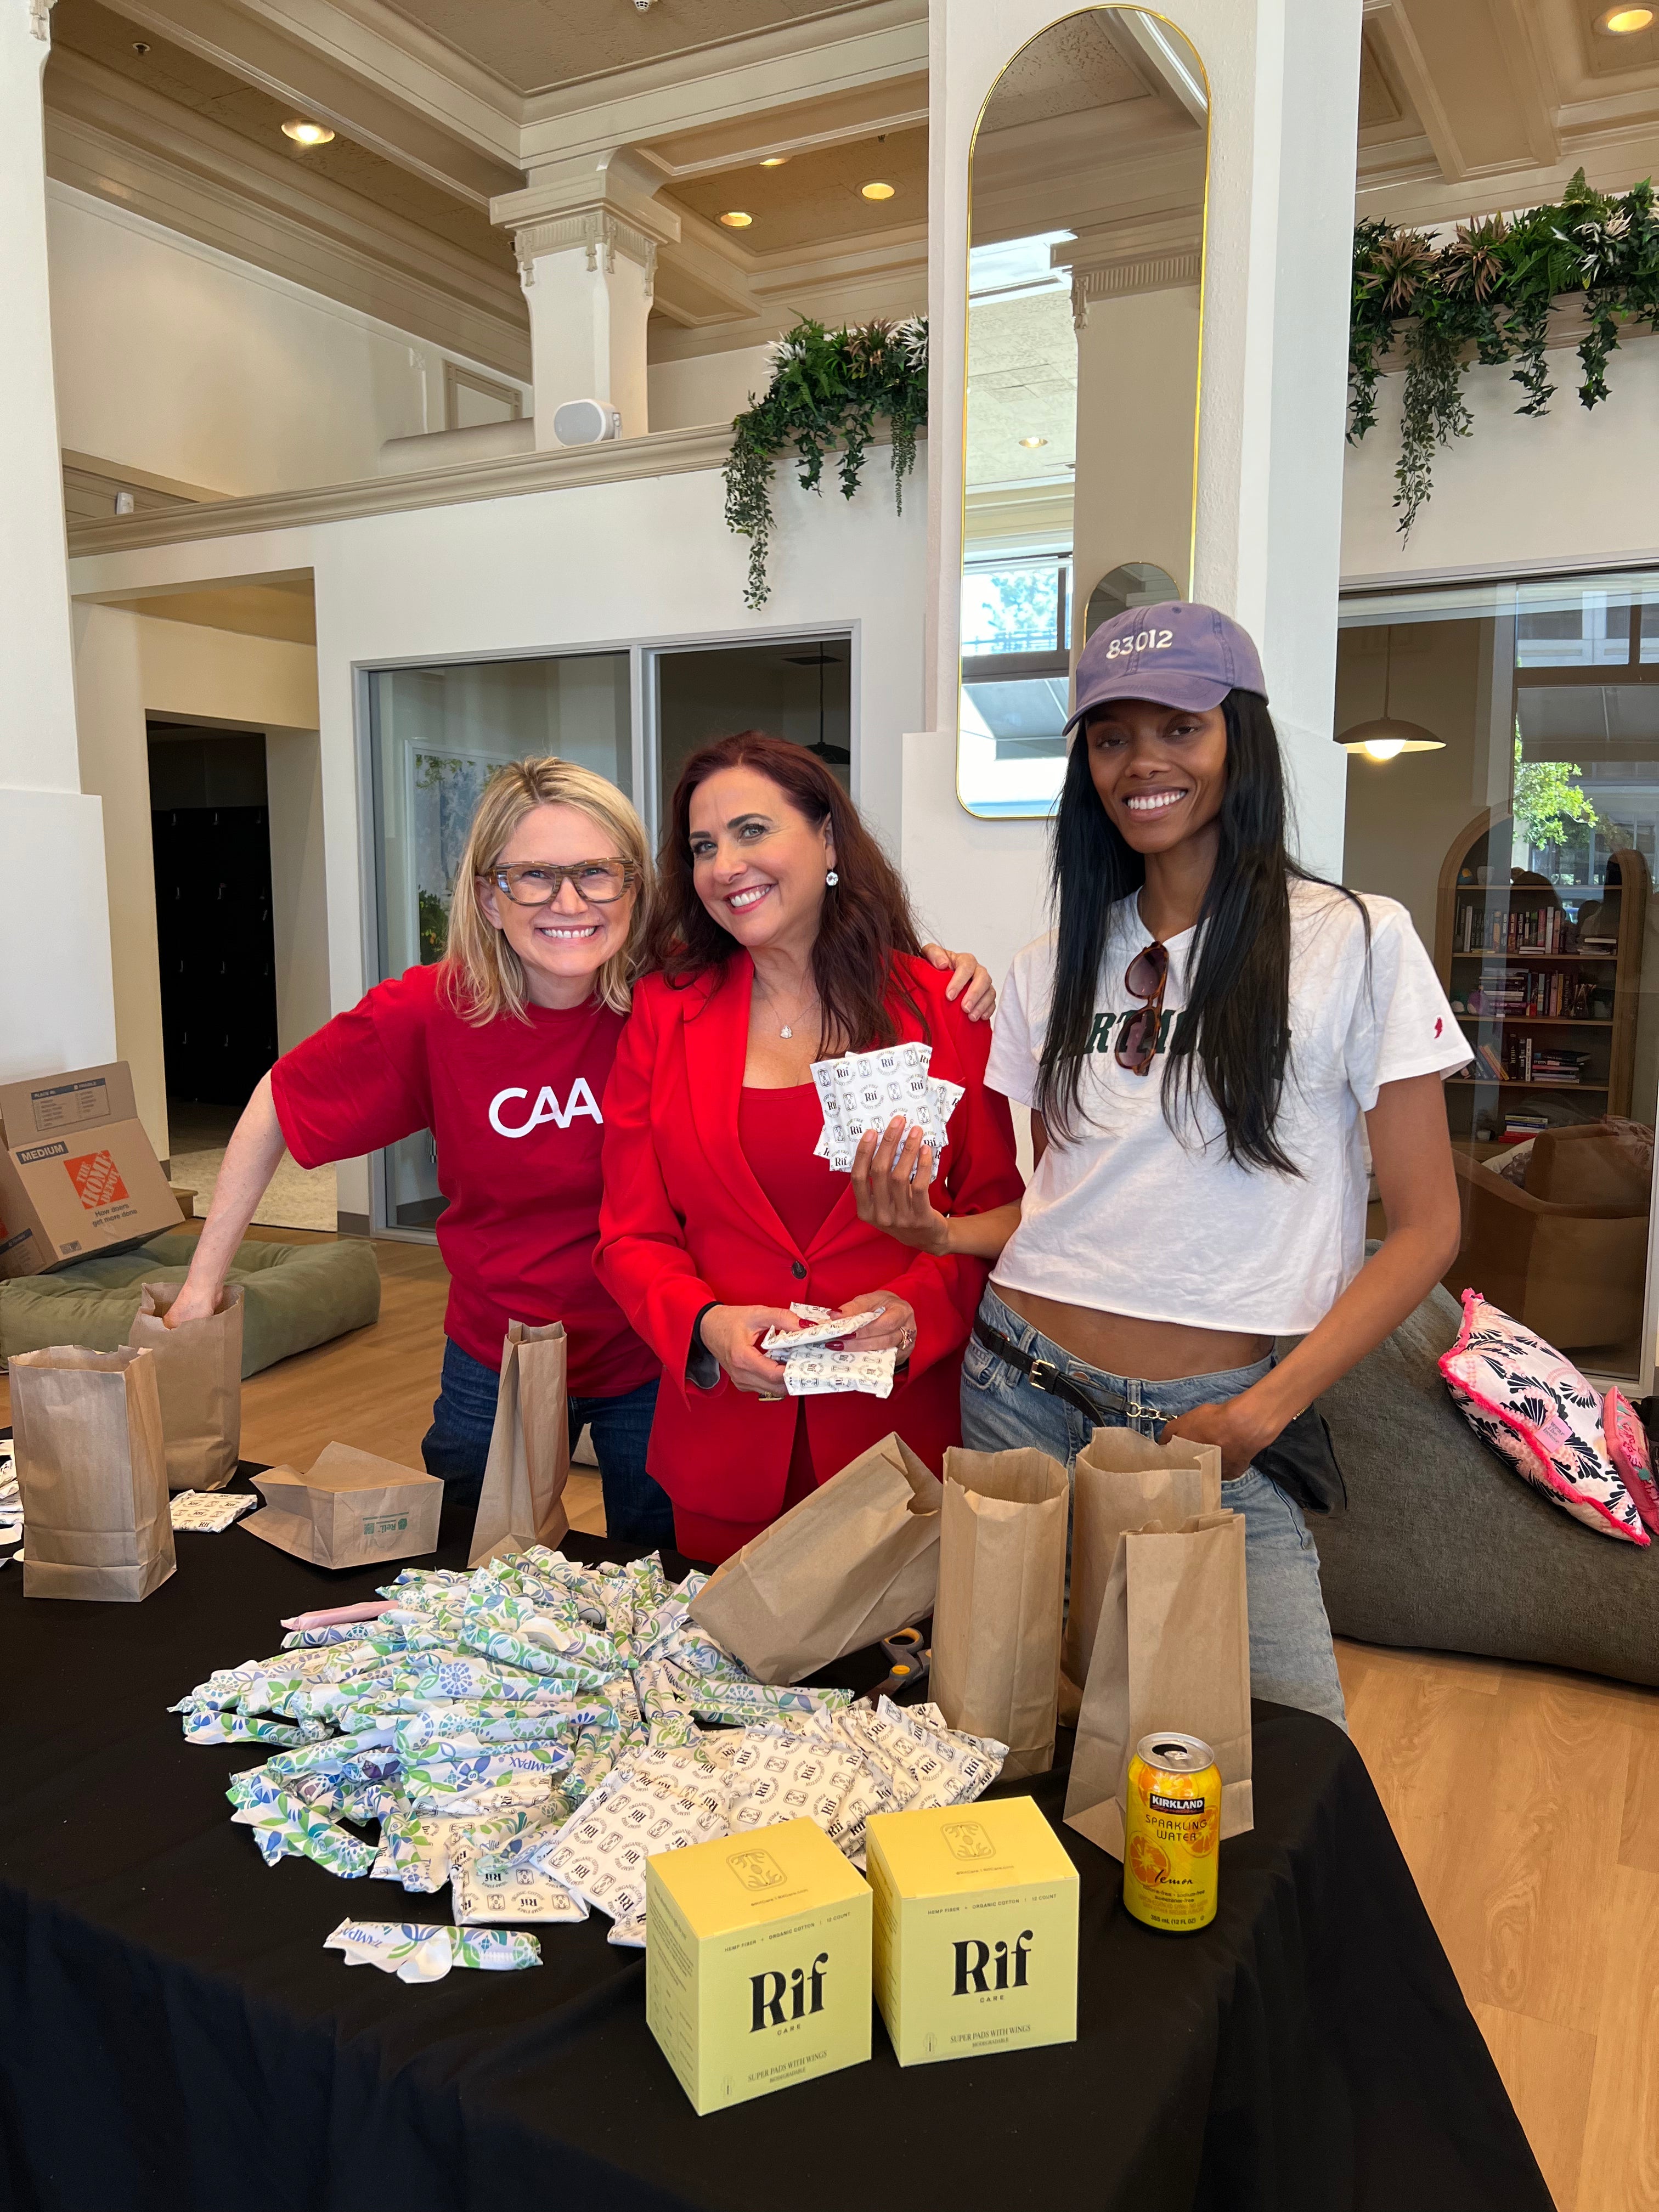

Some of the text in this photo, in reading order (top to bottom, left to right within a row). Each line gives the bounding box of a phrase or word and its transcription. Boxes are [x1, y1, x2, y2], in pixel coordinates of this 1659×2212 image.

[1105, 629, 1173, 659] 83012
[881, 1056, 894, 1068] Rif
[919, 1054, 929, 1064] Ri
[836, 1066, 849, 1079] Rif
[910, 1080, 923, 1091] Rif
[864, 1090, 878, 1102] Rif
[488, 1077, 604, 1138] CAA
[850, 1124, 862, 1135] Rif
[20, 1144, 64, 1163] MEDIUM
[835, 1156, 848, 1166] Rif
[76, 1161, 92, 1183] THE
[81, 1150, 112, 1207] HOME
[100, 1168, 121, 1203] DEPOT
[92, 1218, 103, 1227] get
[872, 1720, 887, 1735] Rif
[781, 1736, 796, 1748] Rif
[651, 1750, 668, 1759] Rif
[737, 1750, 752, 1765] Rif
[698, 1763, 716, 1773] Rif
[800, 1764, 816, 1780] Rif
[921, 1758, 938, 1774] Rif
[964, 1758, 980, 1778] Rif
[636, 1776, 654, 1786] Rif
[755, 1781, 770, 1797] Rif
[677, 1798, 696, 1810] Rif
[701, 1796, 719, 1813] Rif
[821, 1798, 837, 1816] Rif
[1152, 1796, 1204, 1809] KIRKLAND
[628, 1809, 647, 1823] Rif
[1145, 1814, 1207, 1831] SPARKLING
[580, 1824, 599, 1838] Rif
[827, 1819, 844, 1838] Rif
[1156, 1829, 1197, 1842] WATER
[621, 1849, 640, 1864] Rif
[484, 1873, 501, 1882] Rif
[571, 1864, 590, 1879] Rif
[1154, 1869, 1194, 1884] lemon
[521, 1899, 538, 1907] Rif
[614, 1892, 634, 1911] Rif
[725, 1944, 740, 1953] HEMP
[741, 1939, 757, 1948] FIBER
[769, 1929, 793, 1940] ORGANIC
[794, 1922, 815, 1932] COTTON
[833, 1911, 851, 1921] COUNT
[951, 1929, 1034, 1997] Rif
[748, 1951, 829, 2034] Rif
[980, 1995, 1005, 2003] CARE
[777, 2023, 801, 2035] CARE
[950, 2024, 1031, 2044] SUPER PADS WITH WINGS
[748, 2050, 828, 2083] SUPER PADS WITH WINGS
